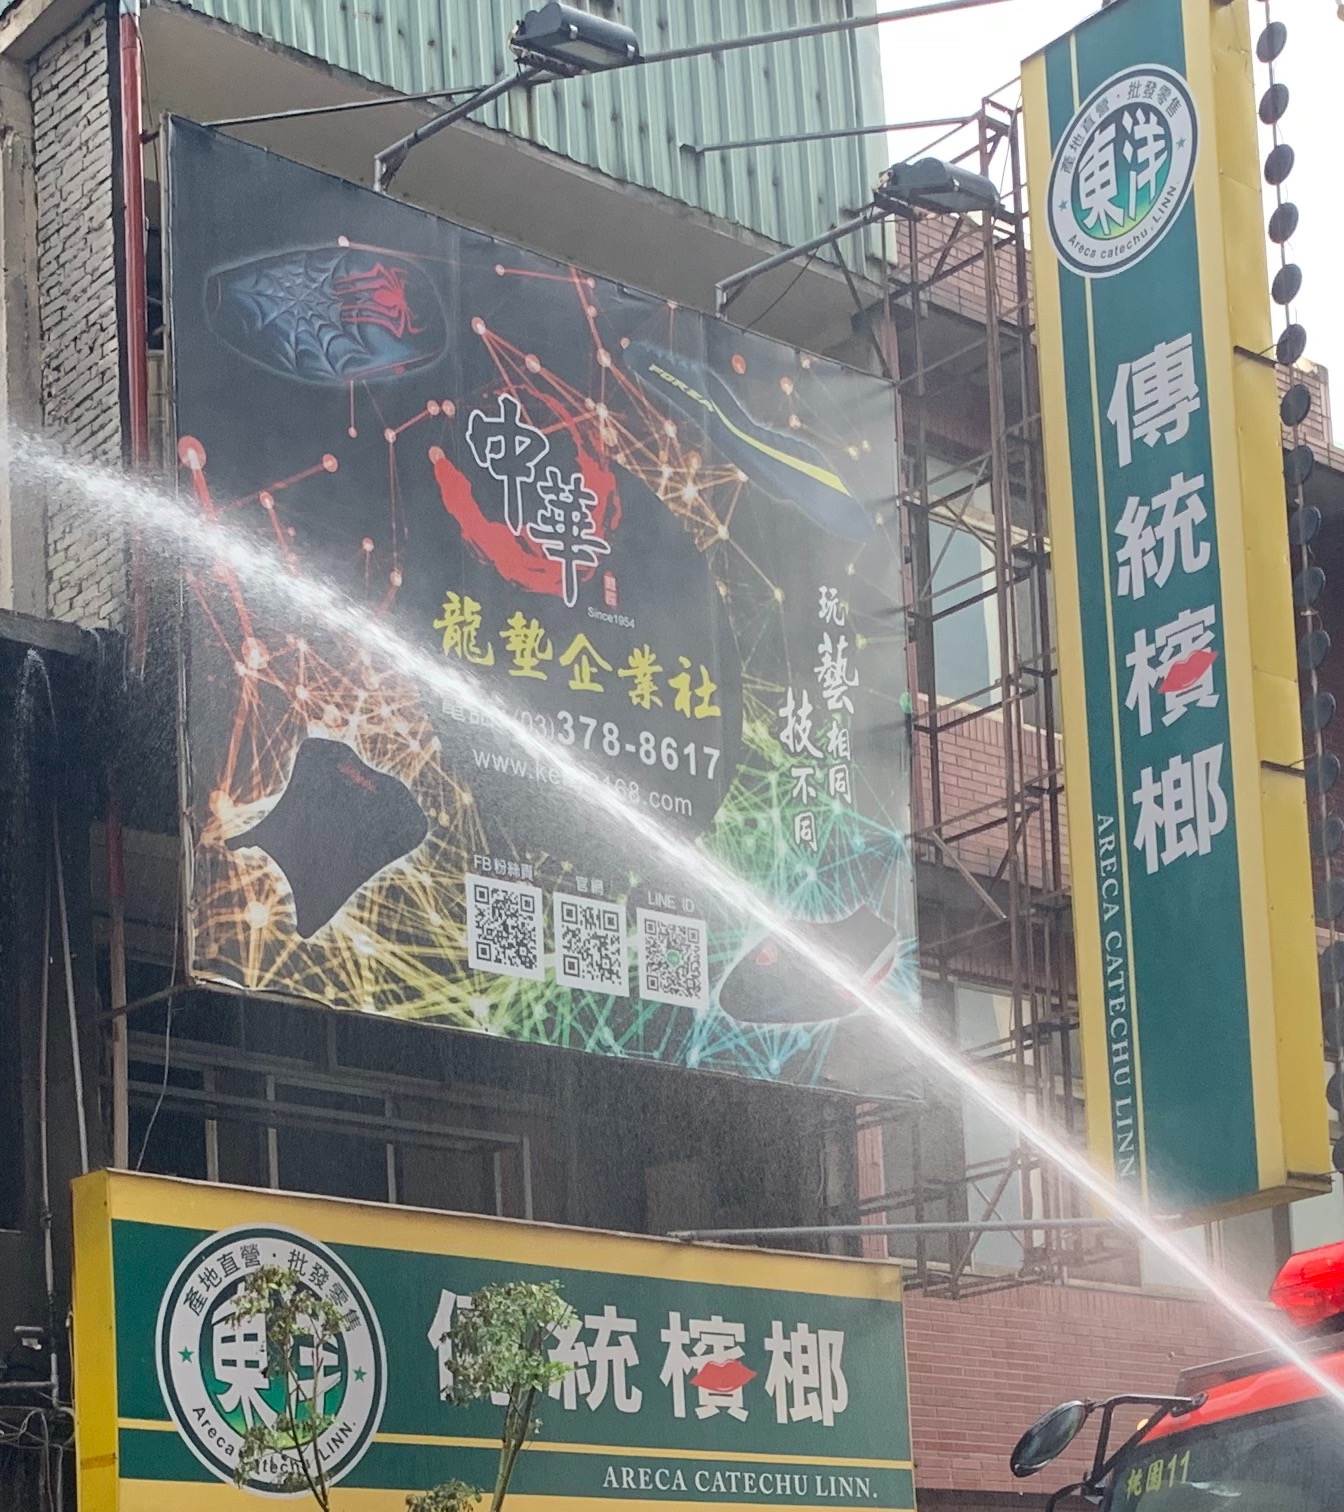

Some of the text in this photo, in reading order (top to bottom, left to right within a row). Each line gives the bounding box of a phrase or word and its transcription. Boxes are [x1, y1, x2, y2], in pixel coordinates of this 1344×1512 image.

[1077, 106, 1169, 237] 東洋
[1067, 233, 1097, 260] Areca
[465, 392, 612, 608] 中華
[432, 590, 722, 720] 龍墊企業社
[1106, 332, 1230, 875] 傳統檳榔
[473, 854, 492, 872] FB
[646, 890, 697, 913] LINE ID
[1096, 812, 1120, 925] ARECA
[1104, 930, 1133, 1087] CATECHU
[427, 1288, 849, 1427] 統檳榔
[191, 1404, 236, 1457] Areca
[602, 1465, 689, 1492] ARECA
[694, 1469, 808, 1498] CATECHU
